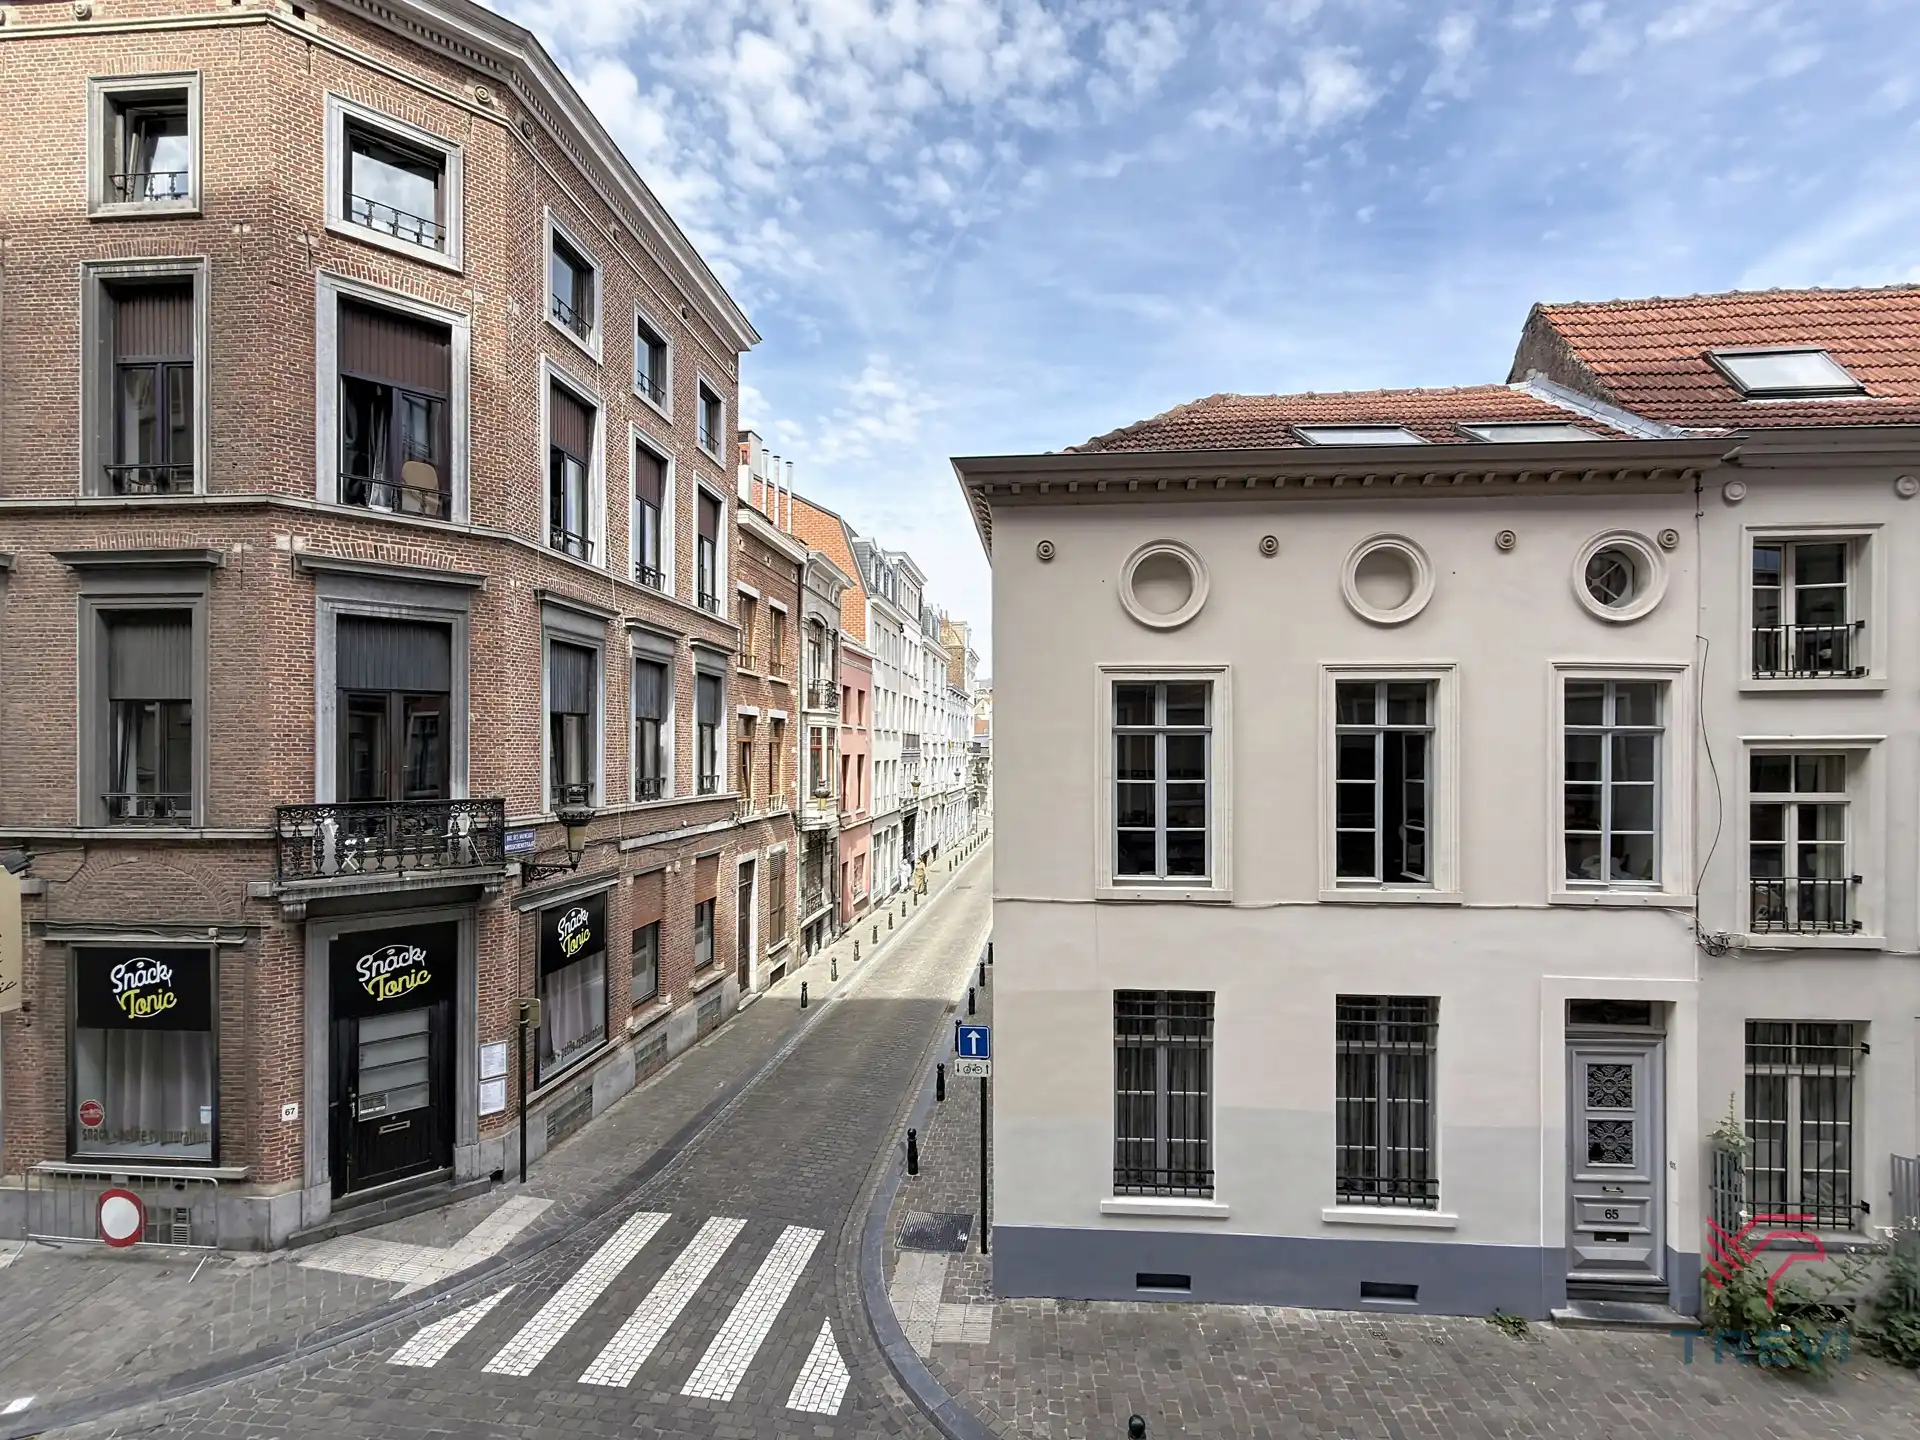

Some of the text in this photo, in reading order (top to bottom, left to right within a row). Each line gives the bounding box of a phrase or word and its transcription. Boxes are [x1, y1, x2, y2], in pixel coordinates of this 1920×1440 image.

[562, 928, 591, 958] Tonic
[367, 969, 432, 1002] Tonic
[120, 988, 178, 1019] Tonic
[284, 1107, 296, 1117] 67
[1605, 1208, 1619, 1220] 65
